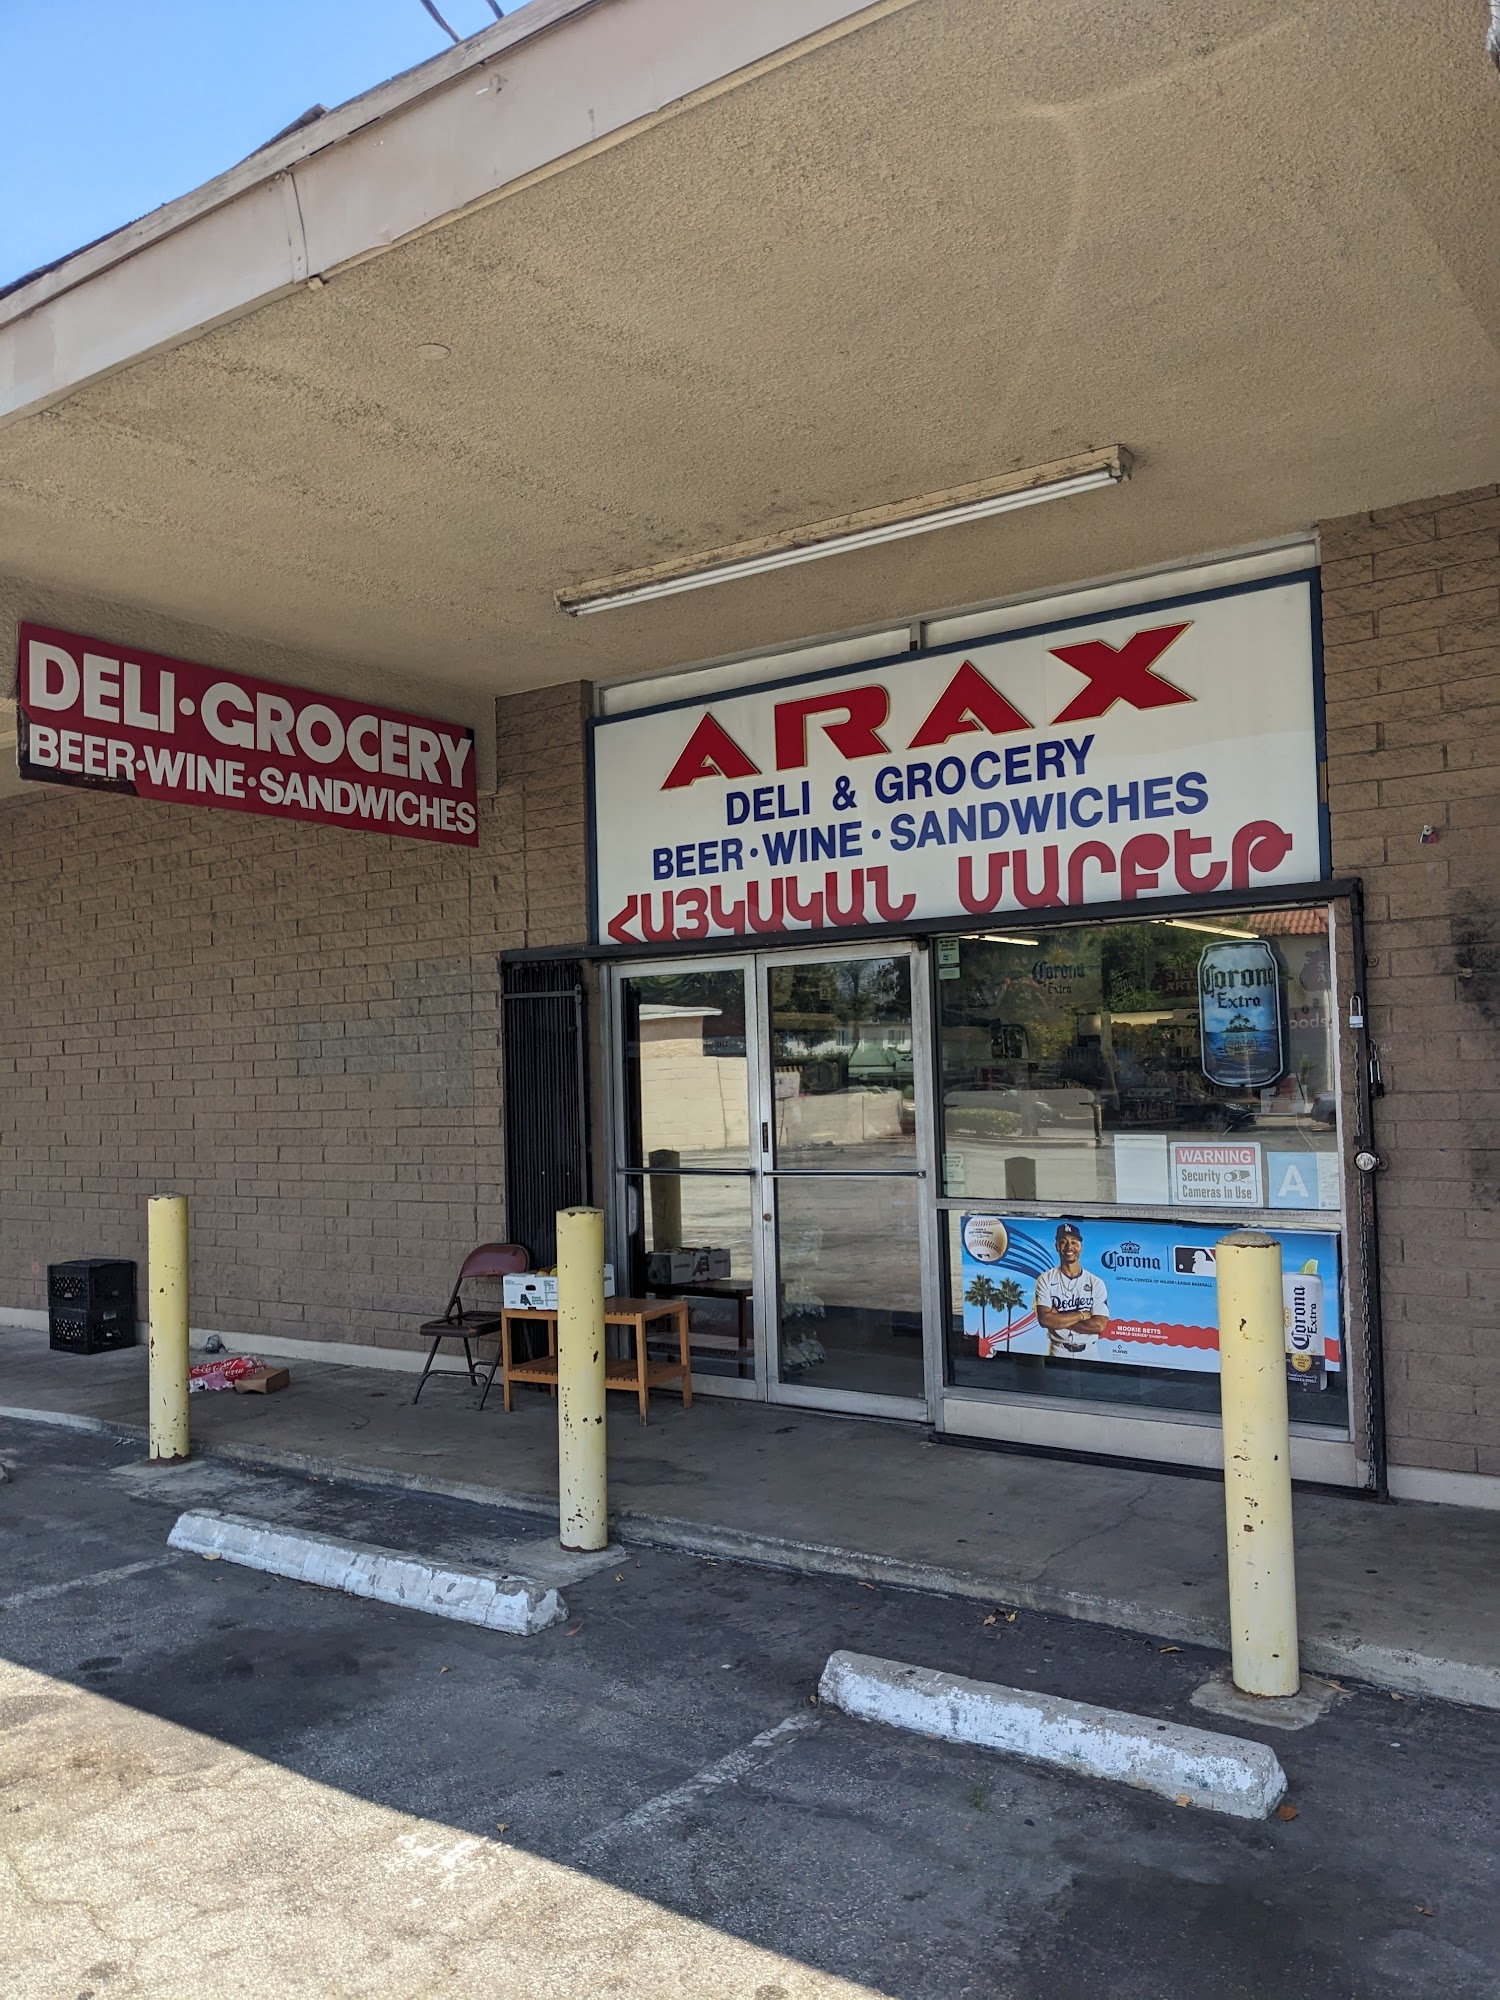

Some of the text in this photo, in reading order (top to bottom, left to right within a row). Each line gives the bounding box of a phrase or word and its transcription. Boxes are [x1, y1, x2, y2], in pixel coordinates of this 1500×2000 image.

[29, 639, 473, 789] DELI GROCERY
[660, 620, 1197, 791] ARAX
[29, 723, 477, 835] BEER WINE SANDWICHES
[726, 734, 1095, 826] DELI & GROCERY
[653, 771, 1209, 881] BEER WINE SANDWICHES
[1216, 990, 1262, 1009] Extra
[1179, 1149, 1251, 1164] WARNING
[1181, 1168, 1221, 1185] Security
[1182, 1186, 1252, 1199] Cameras In Use
[1277, 1164, 1309, 1198] A
[1101, 1250, 1161, 1272] Corona
[1050, 1294, 1094, 1311] Dodgers
[1290, 1285, 1312, 1351] Corona
[1117, 1325, 1161, 1335] MOOKIE BETTS
[1307, 1303, 1318, 1335] Extra
